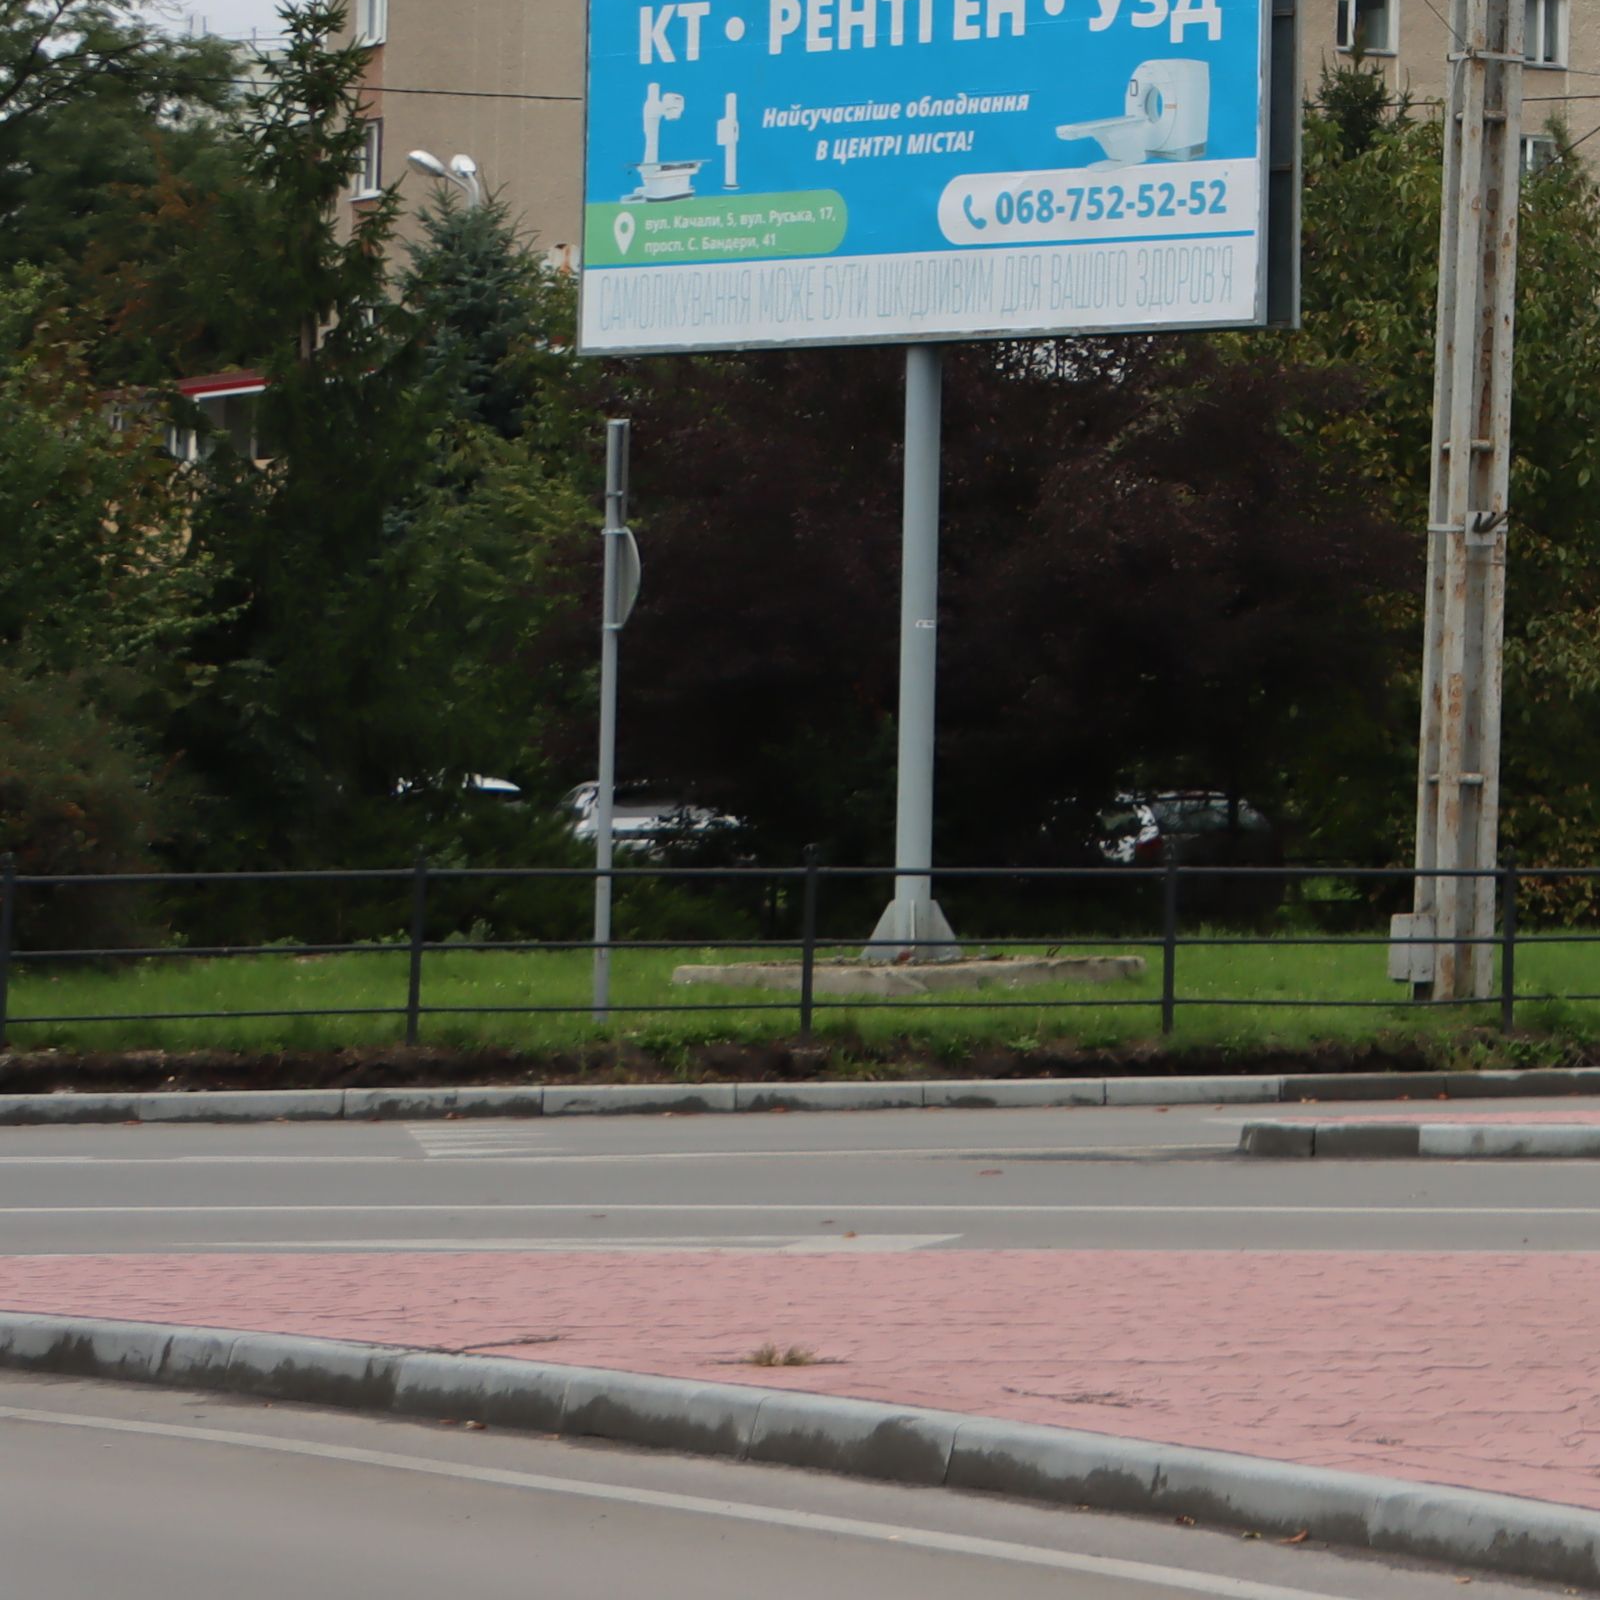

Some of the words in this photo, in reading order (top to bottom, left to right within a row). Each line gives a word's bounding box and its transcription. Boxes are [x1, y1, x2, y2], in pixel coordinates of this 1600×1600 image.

[639, 2, 710, 64] КТ
[762, 98, 901, 131] Найсучасніше
[906, 92, 1030, 119] обладнання
[816, 142, 828, 161] В
[833, 134, 902, 164] ЦЕНТРІ
[907, 130, 975, 155] МІСТА!
[645, 218, 671, 233] вул.
[740, 213, 766, 228] вул.
[768, 208, 816, 228] Руська,
[819, 206, 837, 222] 17,
[995, 179, 1228, 225] 068-752-52-52
[644, 240, 685, 256] просп.
[687, 237, 699, 251] С.
[701, 234, 760, 253] Бандери,
[762, 233, 776, 246] 41
[598, 270, 751, 332] САМОЛІКУВАННЯ
[758, 266, 817, 324] МОЖЕ
[822, 262, 869, 321] БУТИ
[875, 257, 995, 321] ШКІДЛИВИМ
[1000, 254, 1042, 314] ДЛЯ
[1049, 249, 1128, 311] ВАШОГО
[1136, 245, 1234, 312] ЗДОРОВ'Я
